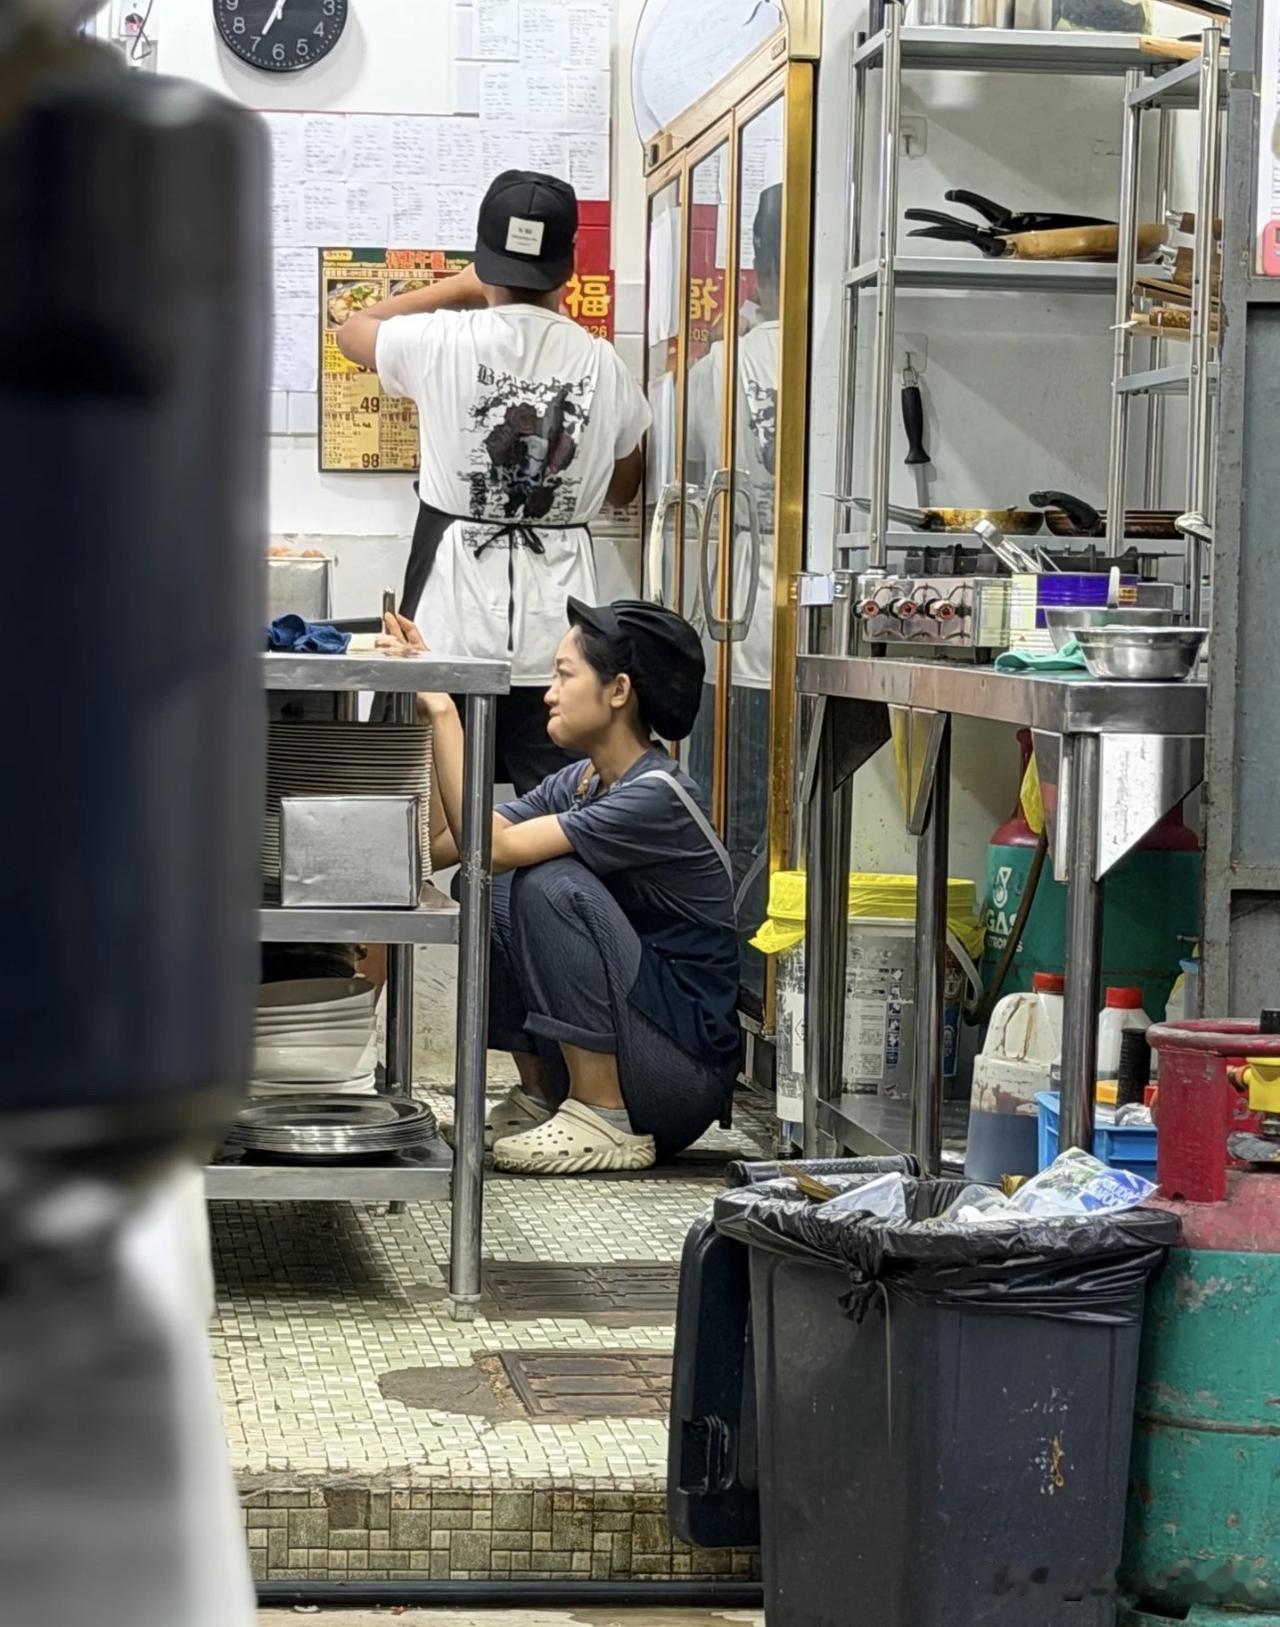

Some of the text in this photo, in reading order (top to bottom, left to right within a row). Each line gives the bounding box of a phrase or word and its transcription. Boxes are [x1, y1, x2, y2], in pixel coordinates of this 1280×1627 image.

[322, 0, 336, 16] 3
[232, 16, 246, 35] 8
[313, 21, 325, 38] 4
[249, 35, 262, 53] 7
[272, 43, 285, 60] 6
[295, 38, 309, 56] 5
[565, 273, 611, 318] 福
[360, 396, 380, 413] 49
[361, 453, 380, 468] 98
